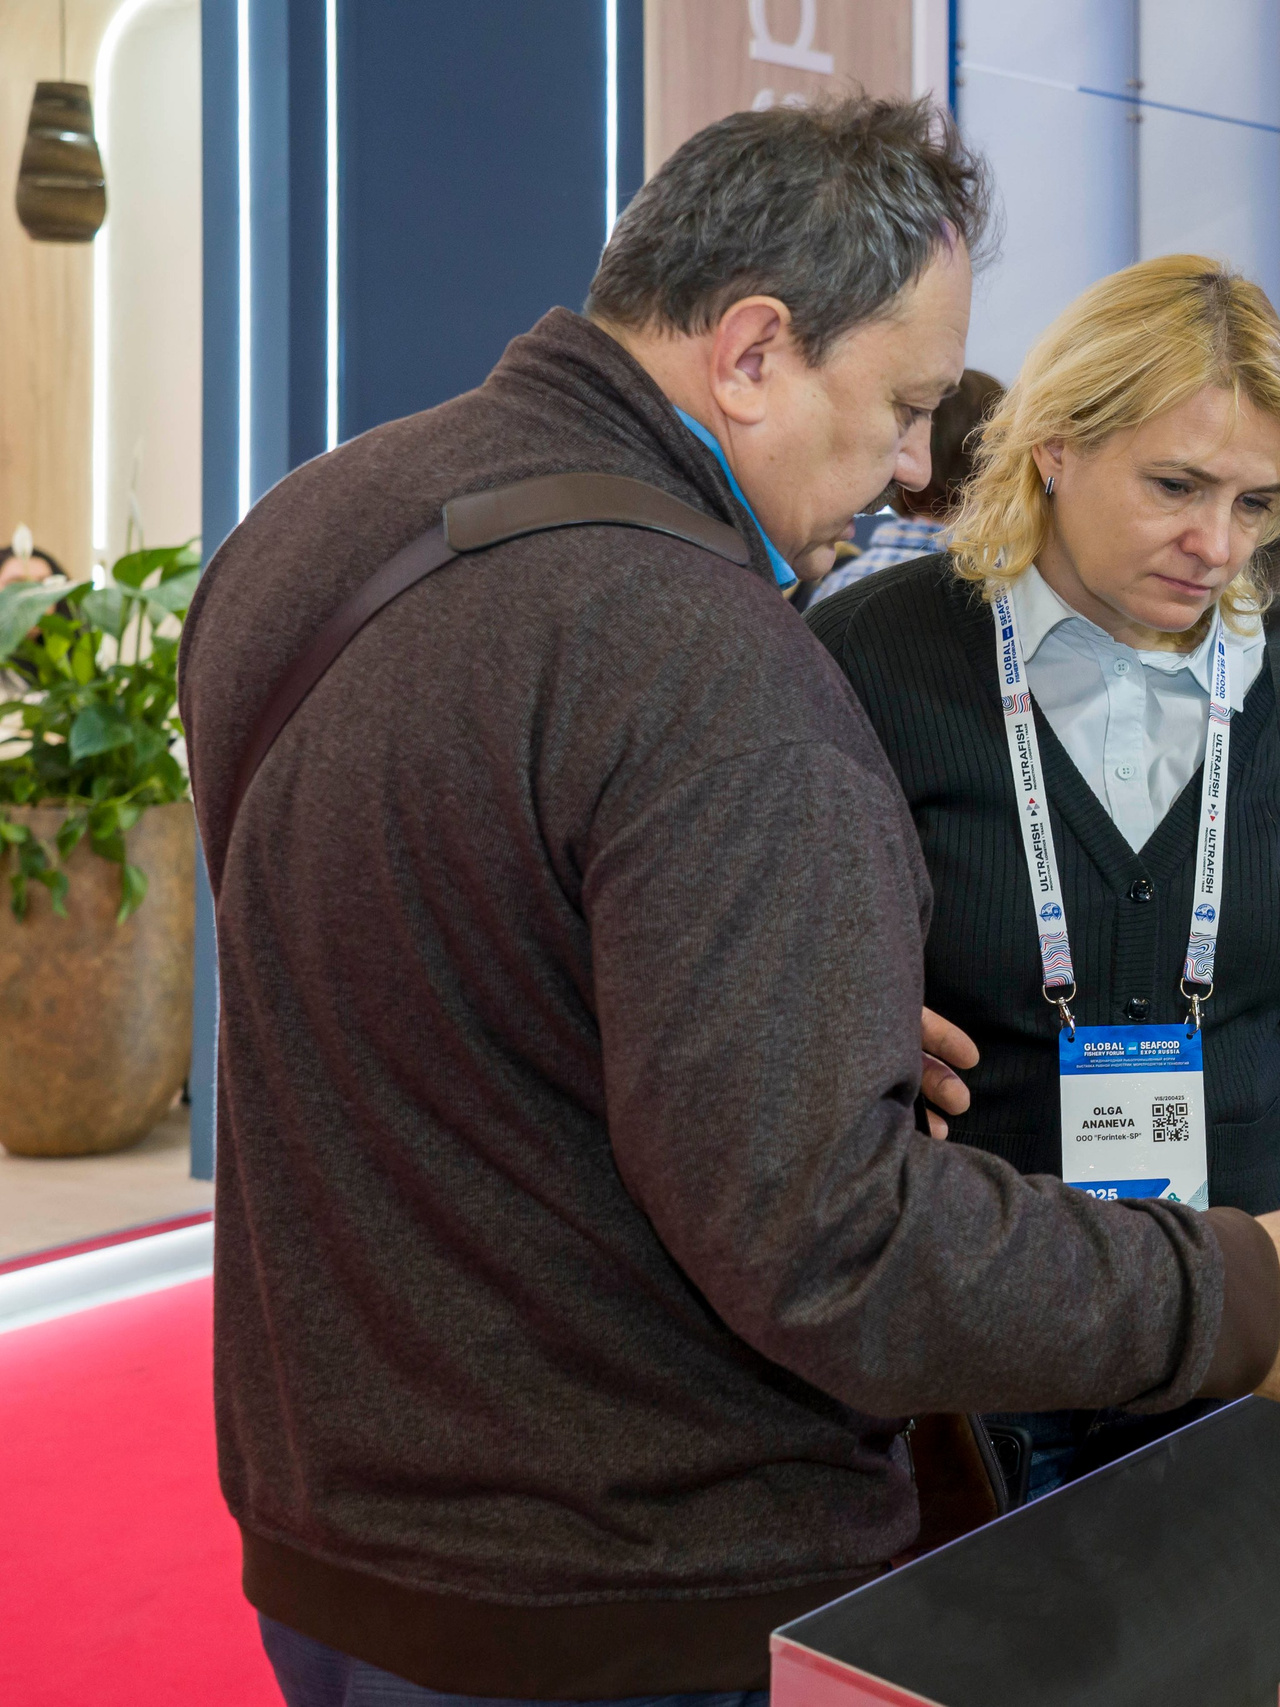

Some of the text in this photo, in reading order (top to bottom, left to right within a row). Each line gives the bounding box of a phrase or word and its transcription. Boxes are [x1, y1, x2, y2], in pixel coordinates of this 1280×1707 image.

[1003, 642, 1014, 684] GLOBAL
[1015, 723, 1032, 791] ULTRAFISH
[1212, 734, 1222, 798] ULTRAFISH
[1031, 823, 1049, 891] ULTRAFISH
[1206, 829, 1216, 893] ULTRAFISH
[1084, 1042, 1124, 1051] GLOBAL
[1140, 1041, 1180, 1049] SEAFOOD
[1082, 1119, 1135, 1129] ANANEVA
[1093, 1106, 1123, 1115] OLGA
[1094, 1133, 1142, 1141] "Forintek-SP"
[1086, 1188, 1118, 1201] 025
